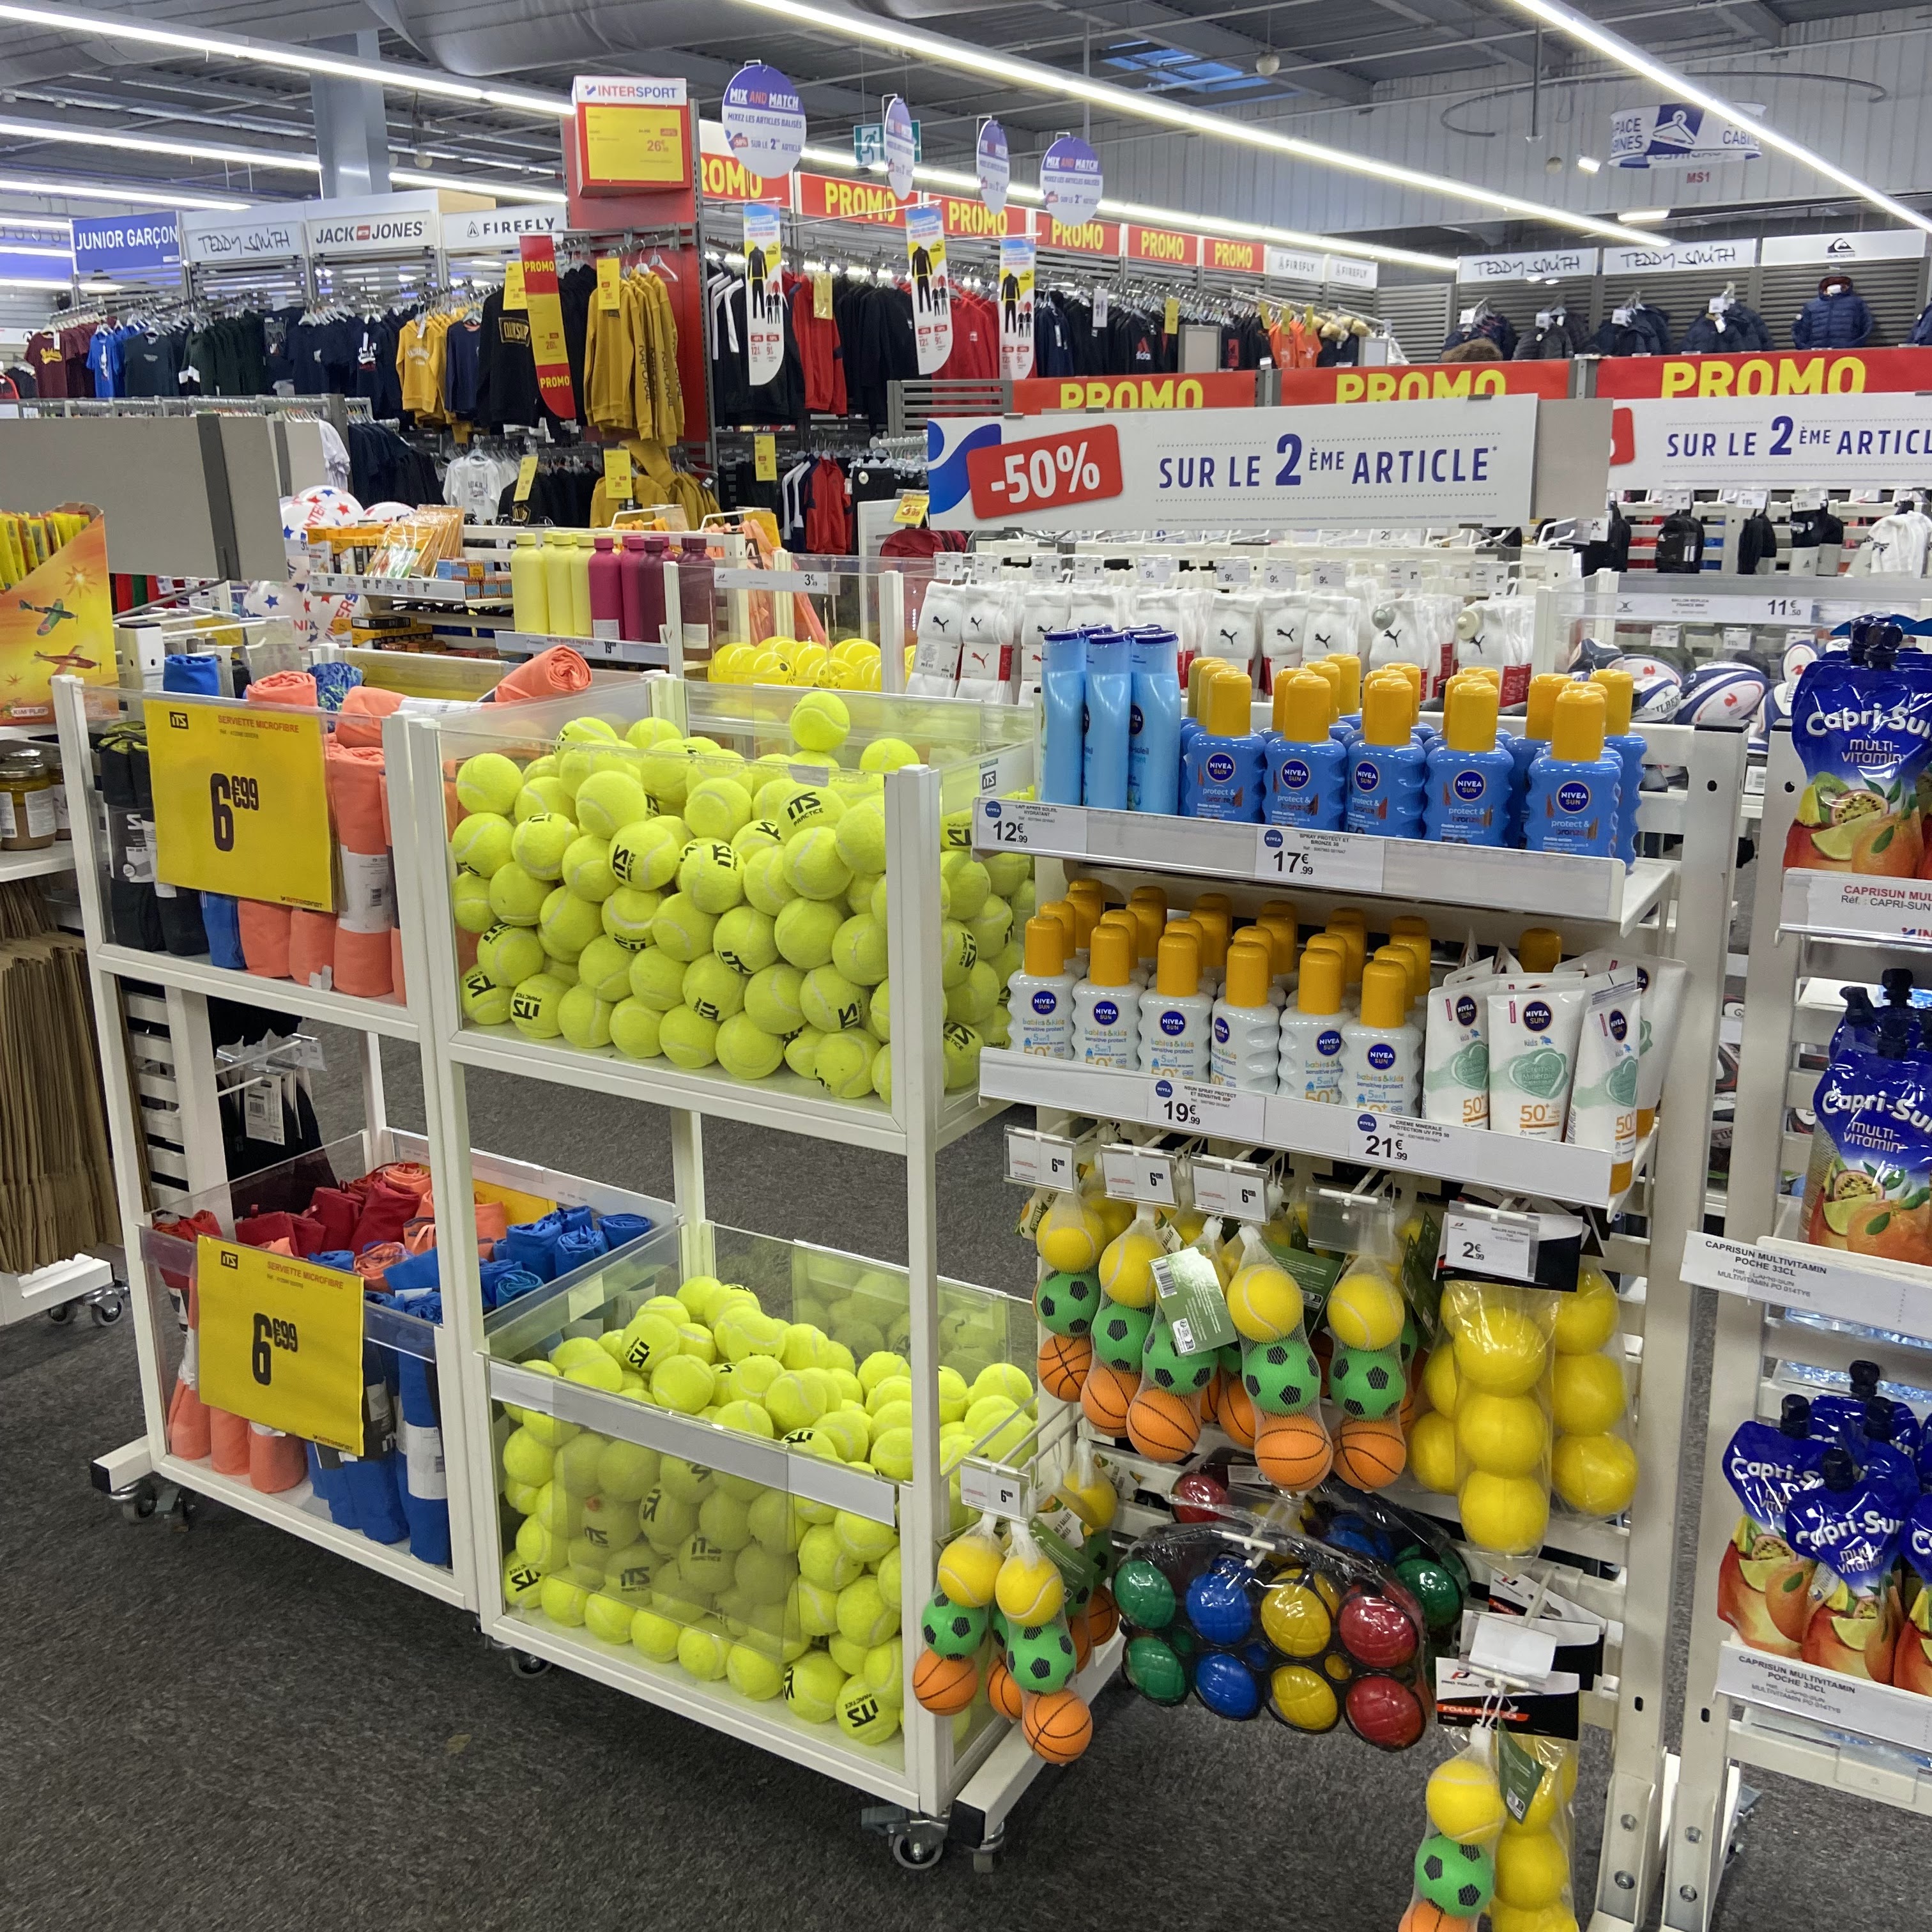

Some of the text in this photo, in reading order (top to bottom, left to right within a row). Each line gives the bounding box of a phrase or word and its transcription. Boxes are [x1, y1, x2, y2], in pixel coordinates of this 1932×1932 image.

[598, 85, 677, 98] INTERSPORT
[730, 88, 799, 111] MIX AND MATCH
[756, 116, 780, 126] ARTICLES
[700, 157, 762, 199] ROMO
[1686, 171, 1711, 183] MS1
[825, 181, 896, 222] PROMO
[483, 217, 555, 235] FIREFLY
[948, 201, 1008, 236] PROMO
[76, 225, 179, 250] JUNIOR GARÇON
[198, 227, 291, 255] TEDDY SMITH
[316, 220, 423, 244] JACK JONES
[1052, 218, 1104, 250] PROMO
[1141, 231, 1184, 261] PROMO
[1215, 241, 1253, 269] PROMO
[1285, 259, 1317, 273] FIREFLY
[1473, 254, 1580, 277] TEDDY SMITH
[1620, 244, 1736, 270] TEDDY SMITH
[524, 261, 555, 273] PROMO
[540, 375, 570, 389] PROMO
[1336, 369, 1506, 404] PROMO
[1661, 356, 1866, 398] PROMO
[1060, 379, 1204, 409] PROMO
[1666, 433, 1716, 457] SUR
[1728, 432, 1757, 456] LE
[1836, 429, 1932, 455] ARTICL
[990, 441, 1101, 505] -50%
[1159, 456, 1215, 489] SUR
[1229, 454, 1261, 487] LE
[218, 715, 299, 733] SERVIETTE MICROFIBRE
[1209, 762, 1232, 770] NIVEA
[1284, 769, 1307, 777] NIVEA
[1358, 770, 1376, 779] NIVEA
[1202, 788, 1223, 796] protect
[1277, 795, 1303, 804] protect
[1351, 797, 1373, 806] protect
[1561, 792, 1587, 800] NIVEA
[787, 791, 822, 819] ITS
[1448, 808, 1478, 816] protect
[793, 808, 824, 827] PRACTICE
[1551, 820, 1583, 829] protect
[612, 844, 631, 877] ITS
[1844, 885, 1906, 899] CAPRISUN
[1869, 896, 1931, 912] CAPRI-SUN
[514, 991, 542, 1003] PRACTICE
[513, 999, 540, 1020] ITS
[1457, 1003, 1475, 1013] NIVEA
[1609, 1018, 1626, 1029] NIVEA
[1389, 1074, 1404, 1082] kids
[1197, 1092, 1222, 1101] SENSITIVE
[1214, 1089, 1237, 1098] PROTECT
[1389, 1124, 1423, 1135] PROTECTION
[1414, 1122, 1443, 1131] MINERALE
[1705, 1240, 1755, 1258] CAPRISUN
[1758, 1253, 1827, 1274] MULTIVITAMIN
[1735, 1256, 1796, 1277] POCHE 33CL
[268, 1261, 302, 1278] SERVIETTE
[303, 1271, 344, 1289] MICROFIBRE
[1717, 1269, 1769, 1290] MULTIVITAMIN
[1738, 1655, 1856, 1694] CAPRISUN MULTIVITAMIN
[1767, 1671, 1802, 1688] POCHE
[1803, 1681, 1826, 1694] 33CL
[847, 1698, 880, 1728] ITS
[1443, 1705, 1471, 1714] FOAM
